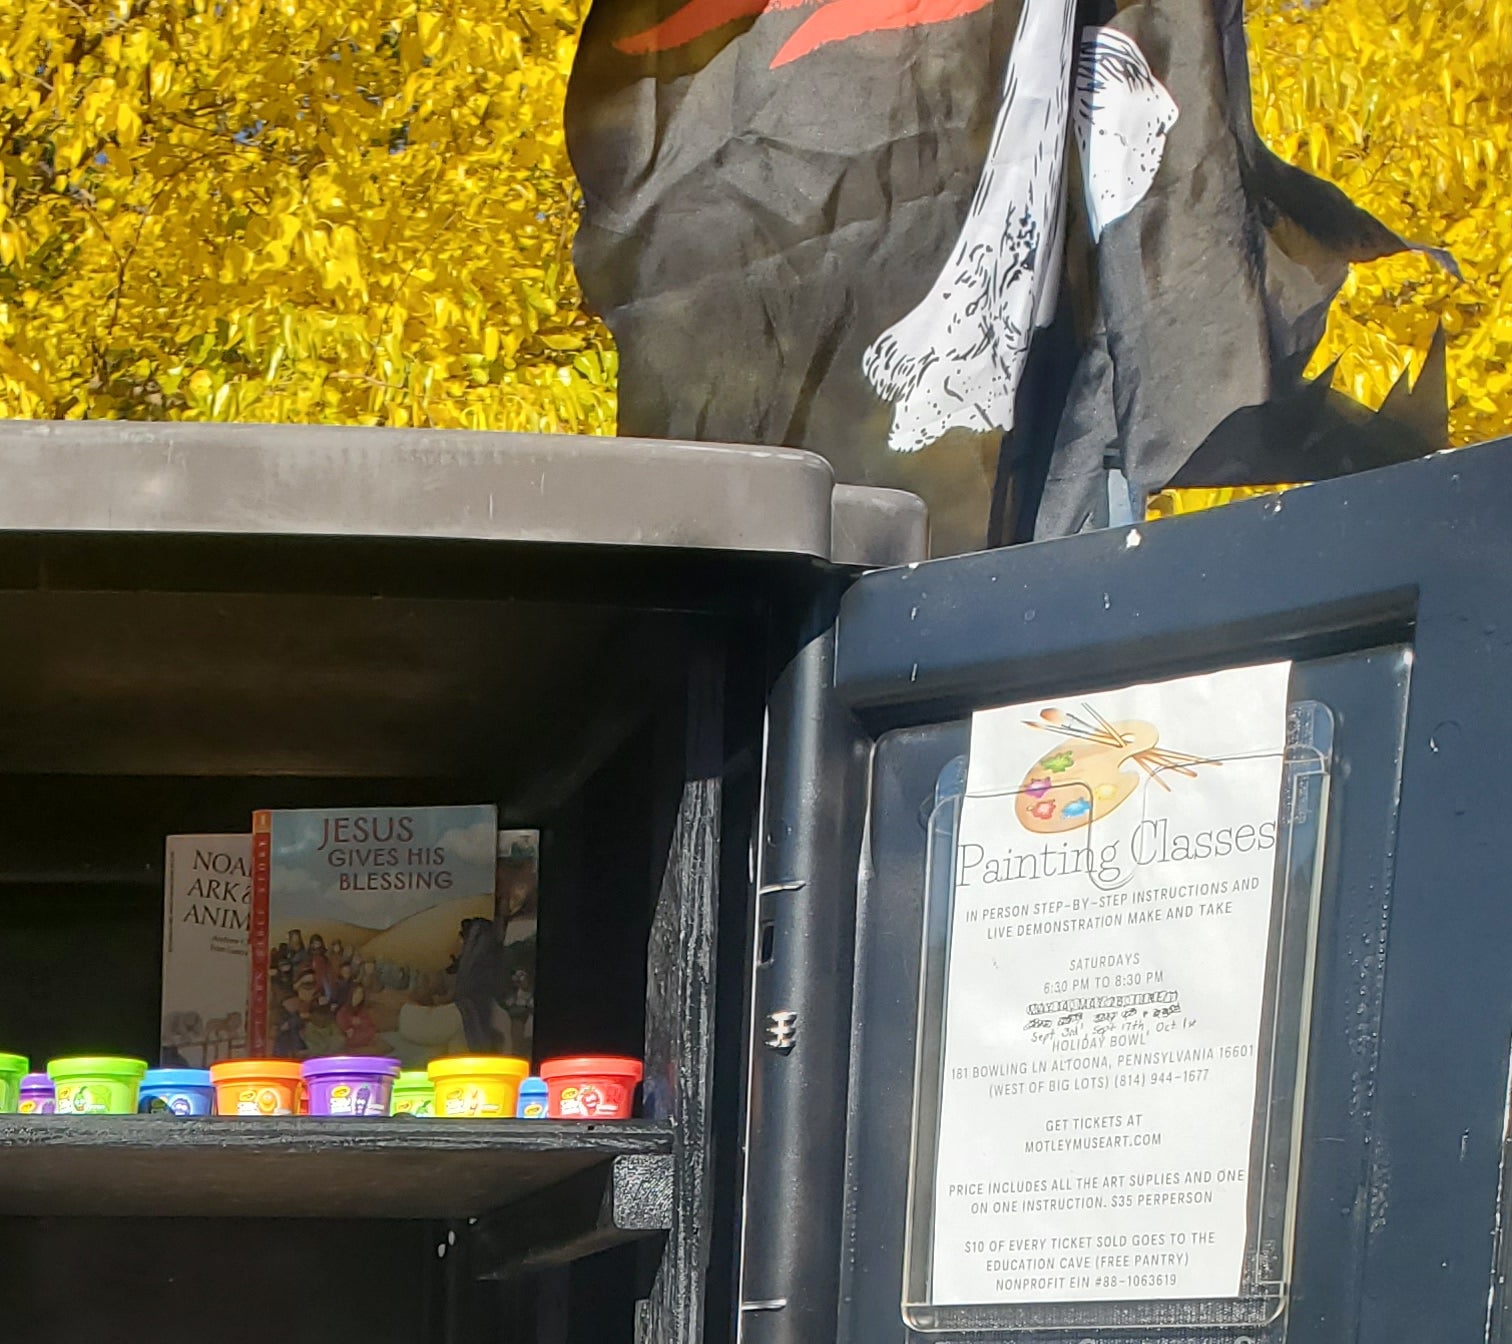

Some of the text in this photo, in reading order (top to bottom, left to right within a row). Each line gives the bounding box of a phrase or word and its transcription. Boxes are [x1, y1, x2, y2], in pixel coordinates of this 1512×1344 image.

[317, 816, 415, 850] JESUS
[193, 849, 252, 877] NOA
[328, 846, 445, 868] GIVES HIS
[956, 818, 1276, 887] Painting Classes
[187, 877, 239, 902] ARK
[339, 870, 454, 892] BLESSING
[965, 878, 1259, 923] IN PERSON STEP-BY-STEP INSTRUCTIONS AND
[184, 903, 252, 931] ANIM
[986, 902, 1232, 940] LIVE DEMONSTRATION MAKE AND TAKE
[1068, 953, 1140, 972] SATURDAYS
[1042, 972, 1163, 995] 6:30 PM TO 8:30 PM
[1051, 1034, 1146, 1053] HOLIDAY BOWL
[951, 1045, 1256, 1081] 181 BOWLING LN ALTOONA, PENNSYLVANIA 16601
[988, 1069, 1209, 1098] (WEST OF BIG LOTS) (814) 944-1677
[1045, 1115, 1143, 1132] GET TICKETS AT
[1024, 1134, 1161, 1153] MOTLEYMUSEART.COM
[948, 1169, 1246, 1196] PRICE INCLUDES ALL THE ART SUPLIES AND ONE
[970, 1192, 1212, 1215] ON ONE INSTRUCTION. $35 PERPERSON
[963, 1232, 1215, 1253] $10 OF EVERY TICKET SOLD GOES TO THE
[985, 1253, 1189, 1272] EDUCATION CAVE (FREE PANTRY)
[995, 1273, 1176, 1291] NONPROFIT EIN #88-1063619
